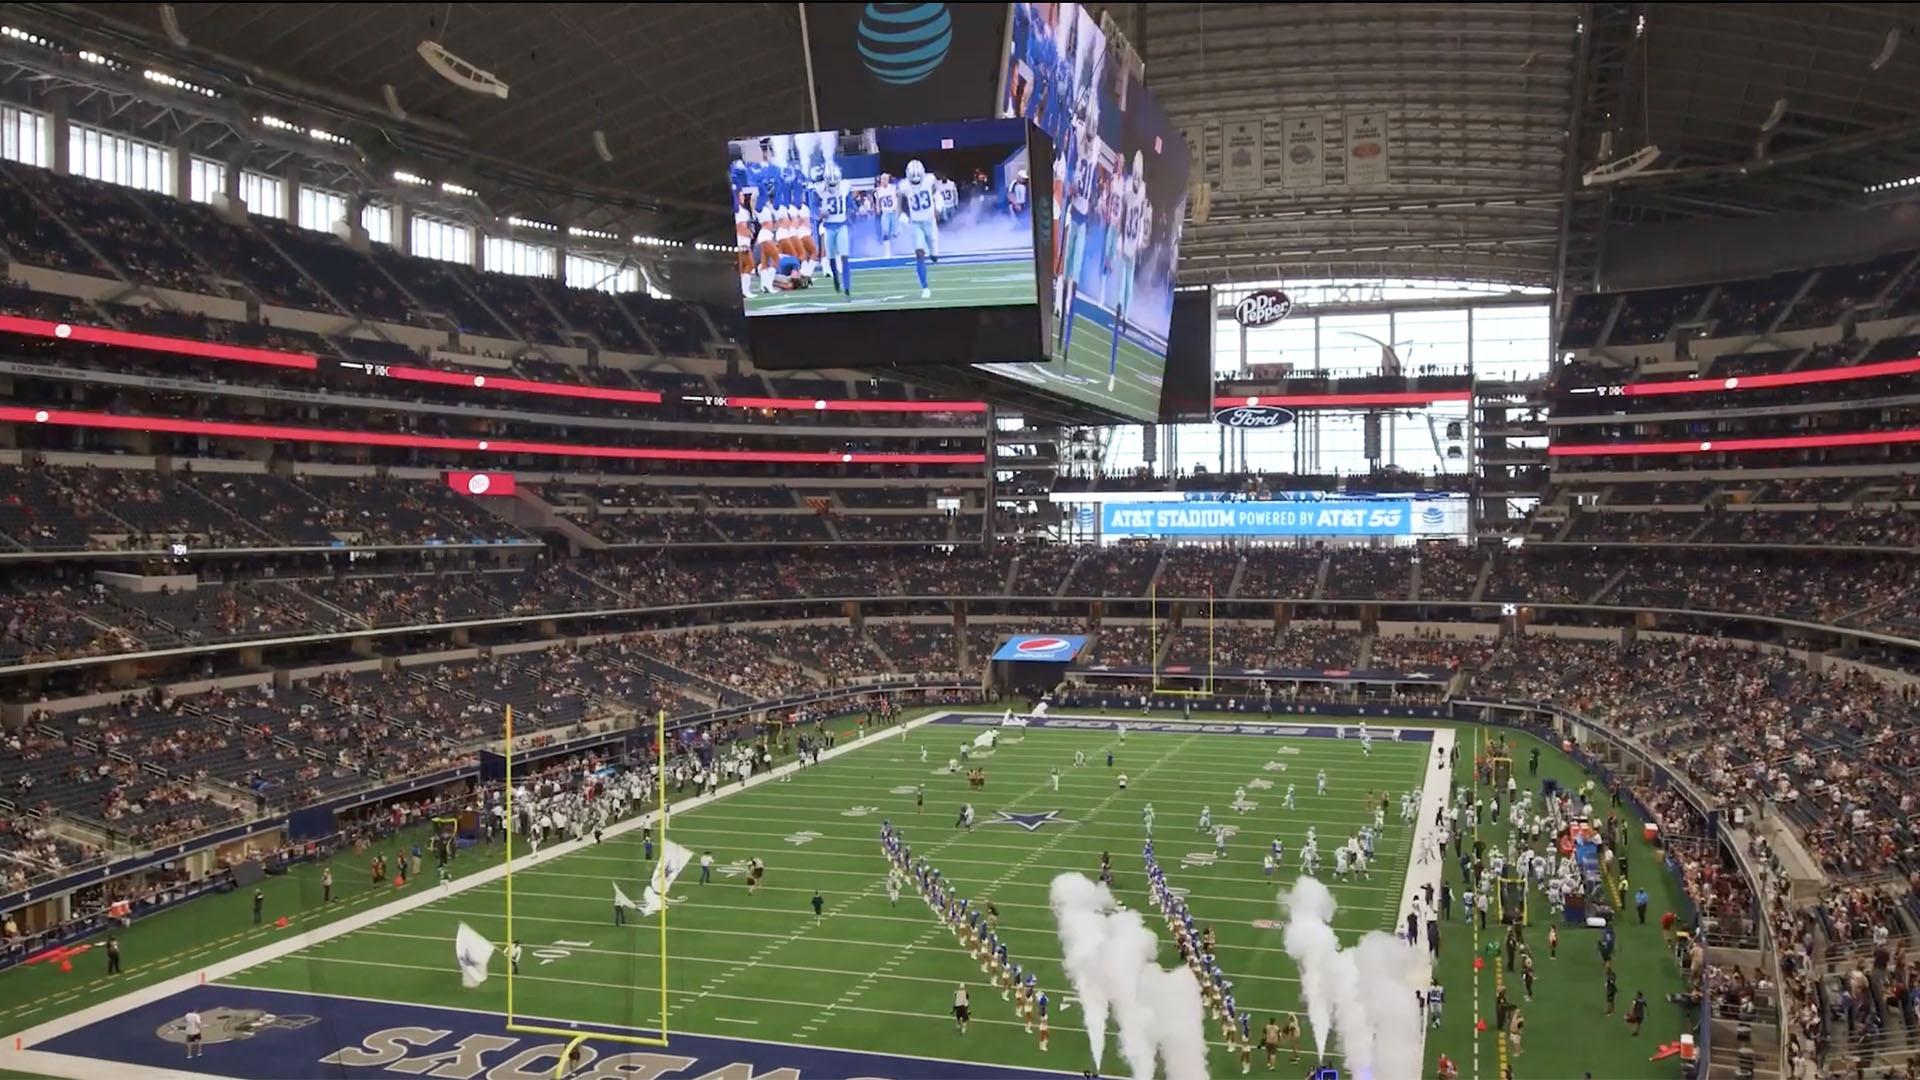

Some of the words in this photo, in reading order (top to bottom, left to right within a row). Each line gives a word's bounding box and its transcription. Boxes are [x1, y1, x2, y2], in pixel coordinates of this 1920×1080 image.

[826, 196, 843, 215] 31
[1236, 298, 1289, 324] Pepper
[1256, 295, 1276, 310] Dr
[1230, 409, 1279, 426] Ford
[1112, 510, 1154, 527] AT&T
[1158, 509, 1236, 527] STADIUM
[1239, 511, 1296, 526] POWERED
[1300, 512, 1314, 526] BY
[1317, 509, 1367, 527] AT&T
[1368, 510, 1402, 527] 5G
